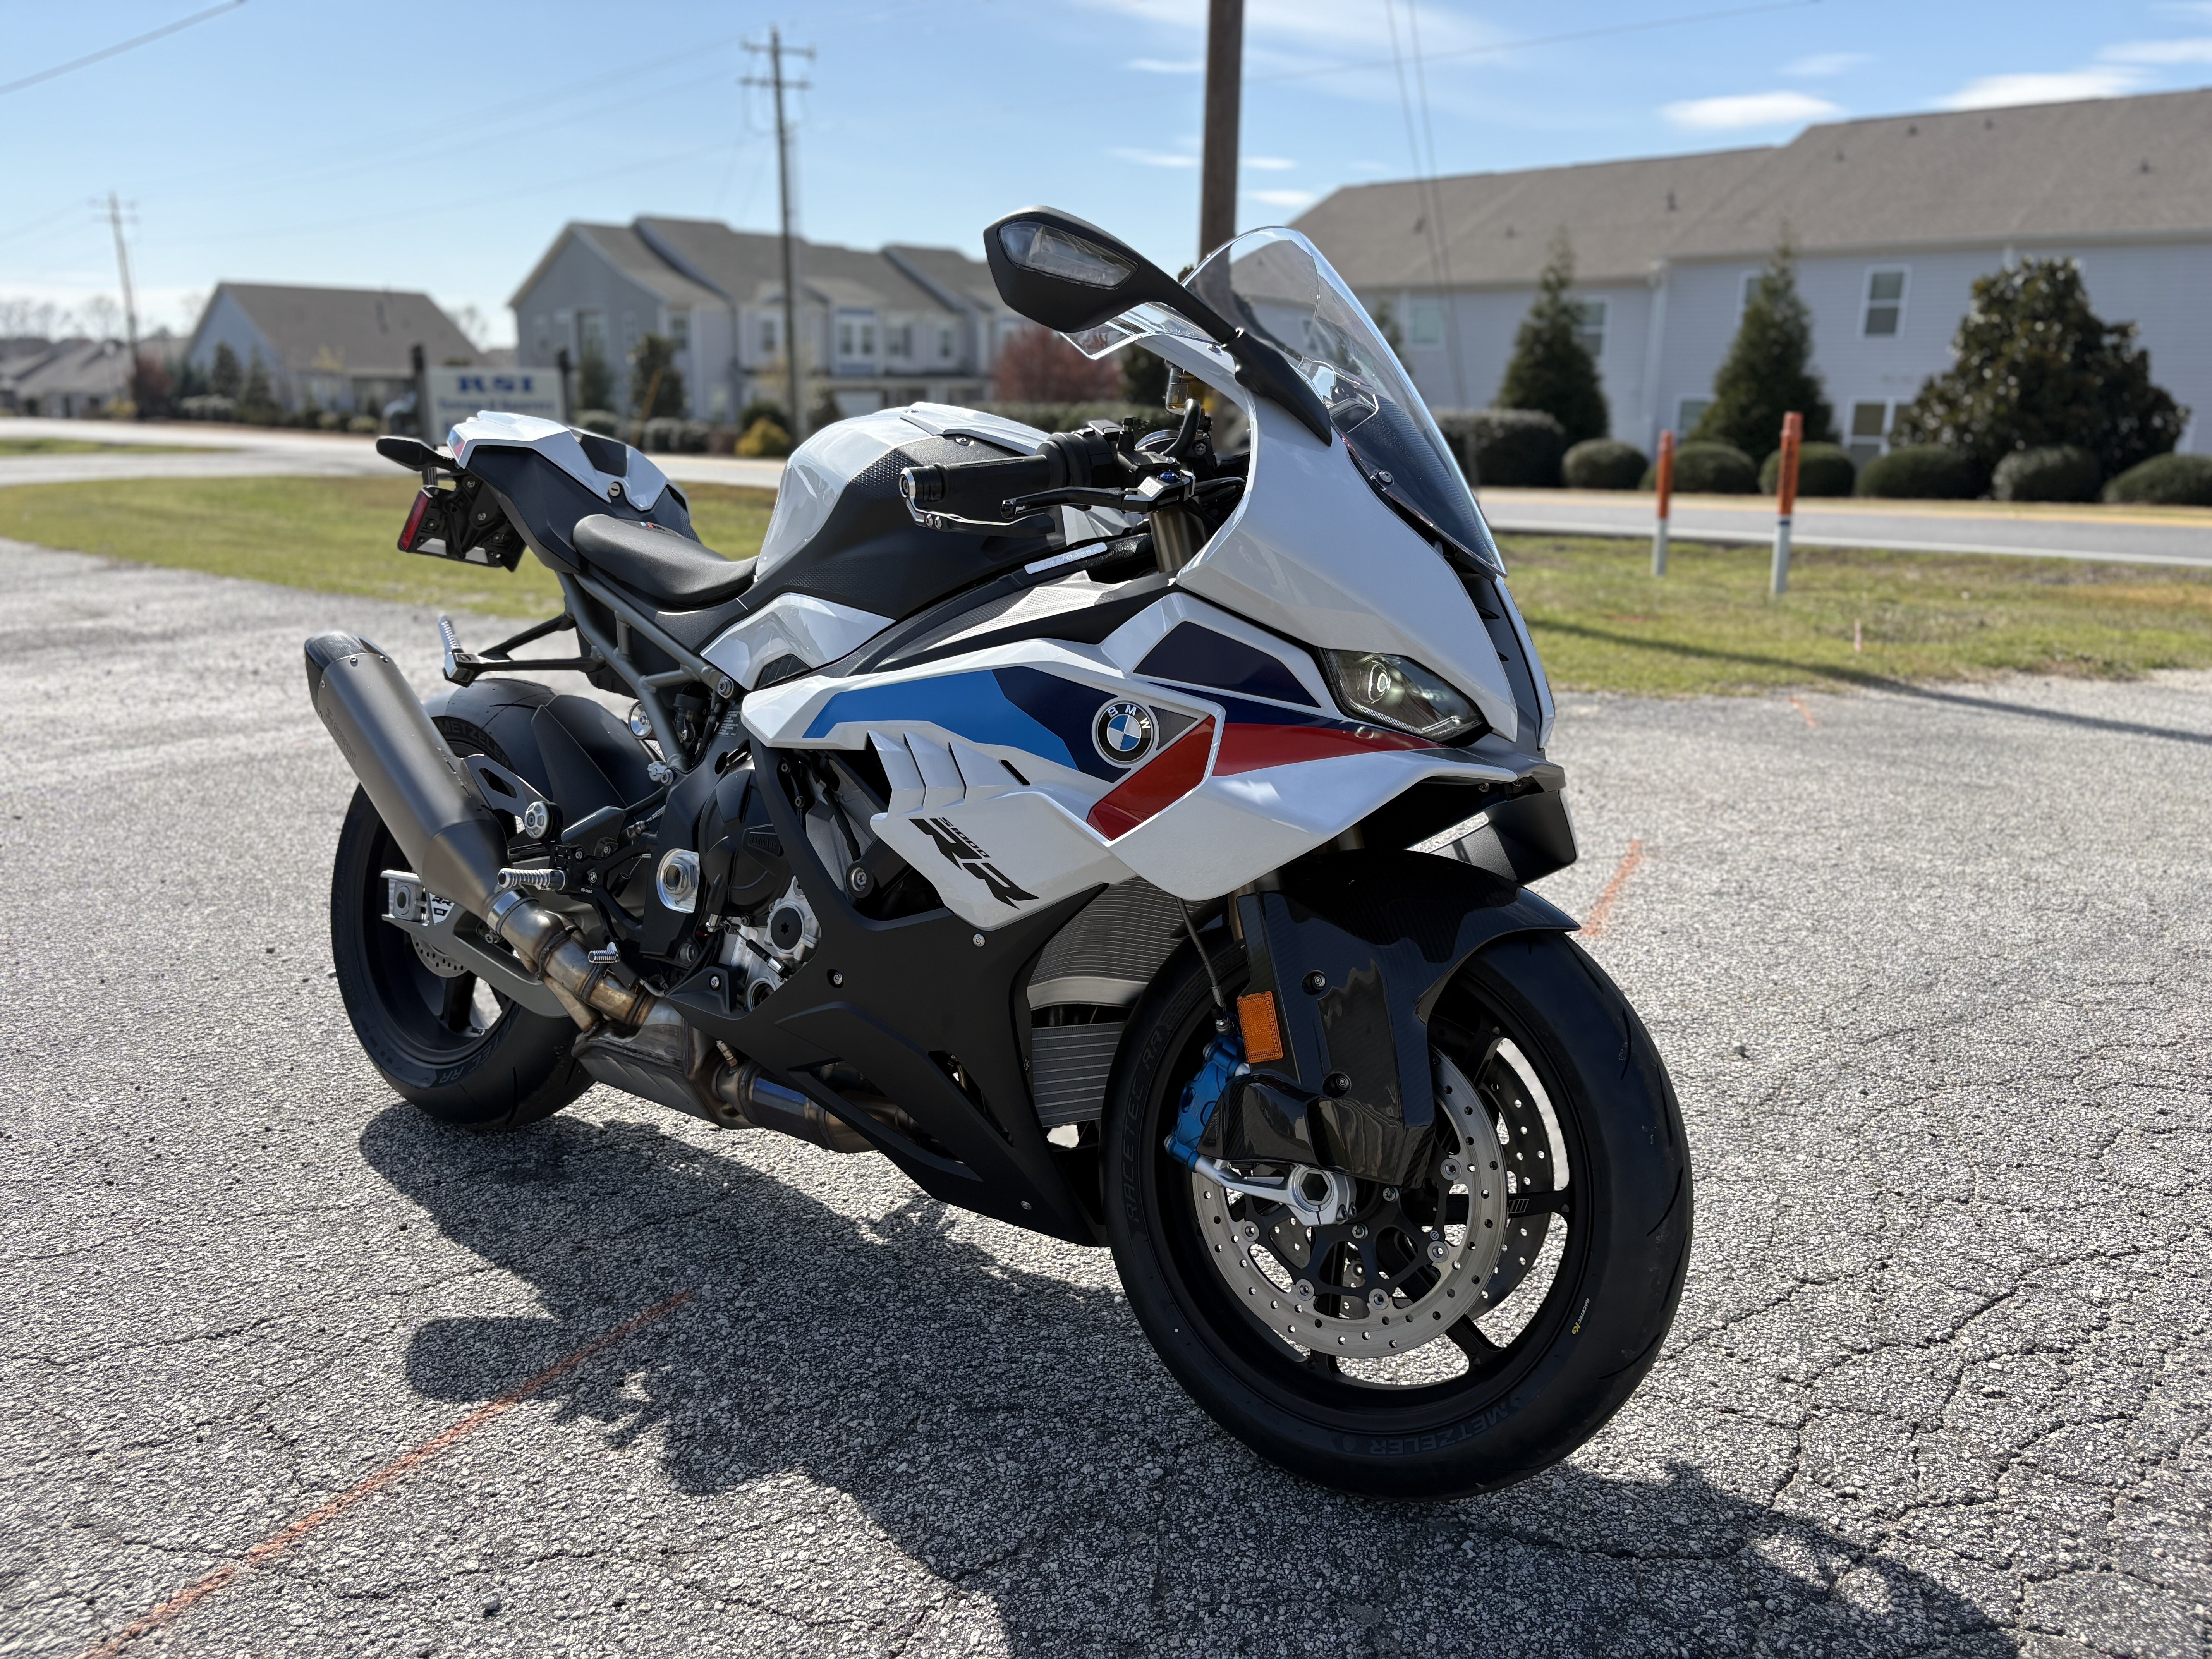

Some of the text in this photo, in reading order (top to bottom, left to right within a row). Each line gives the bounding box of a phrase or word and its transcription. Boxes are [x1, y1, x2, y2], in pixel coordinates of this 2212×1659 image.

[457, 375, 533, 393] RSI
[1108, 704, 1151, 729] BMW
[438, 720, 509, 768] METZELER
[751, 835, 776, 849] BMW
[939, 817, 991, 858] S1000
[908, 818, 1040, 910] RR
[439, 1066, 464, 1083] RR
[1123, 1030, 1162, 1223] RACETEC RR
[1369, 1404, 1509, 1455] METZELER
